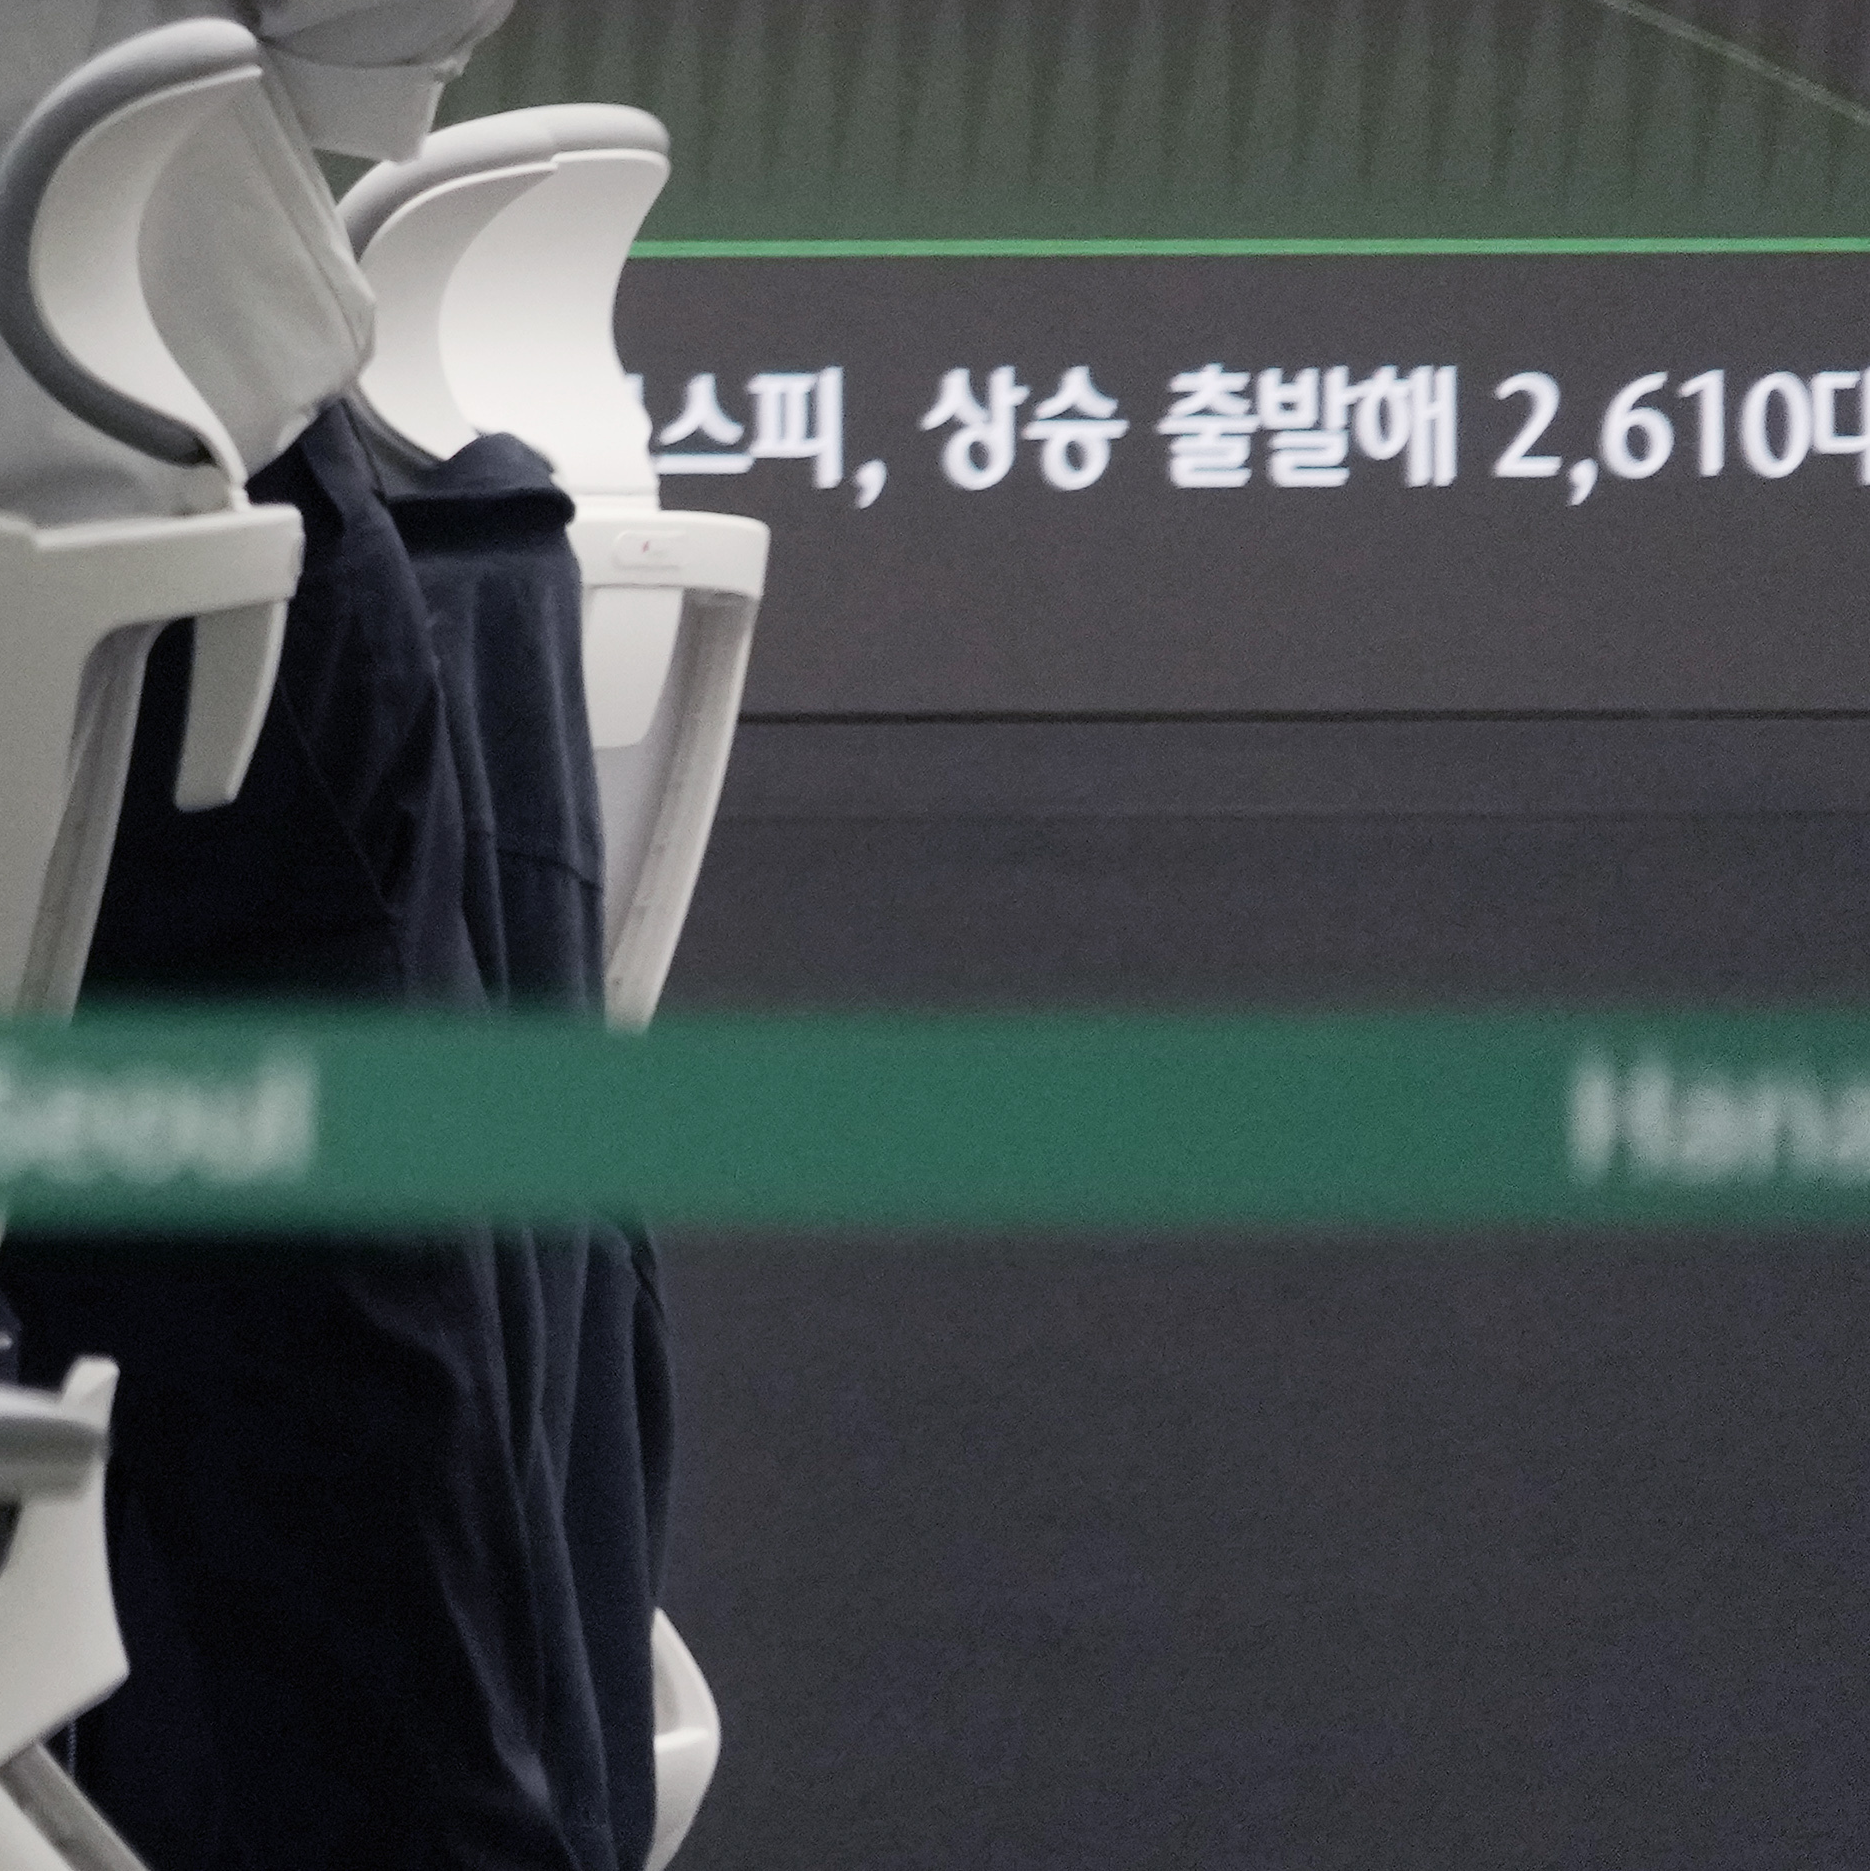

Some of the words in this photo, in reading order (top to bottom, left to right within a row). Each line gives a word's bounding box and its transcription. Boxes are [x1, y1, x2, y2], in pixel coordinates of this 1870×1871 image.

[625, 364, 889, 510] 스피,
[919, 364, 1130, 491] 상승
[1155, 362, 1459, 489] 출발해
